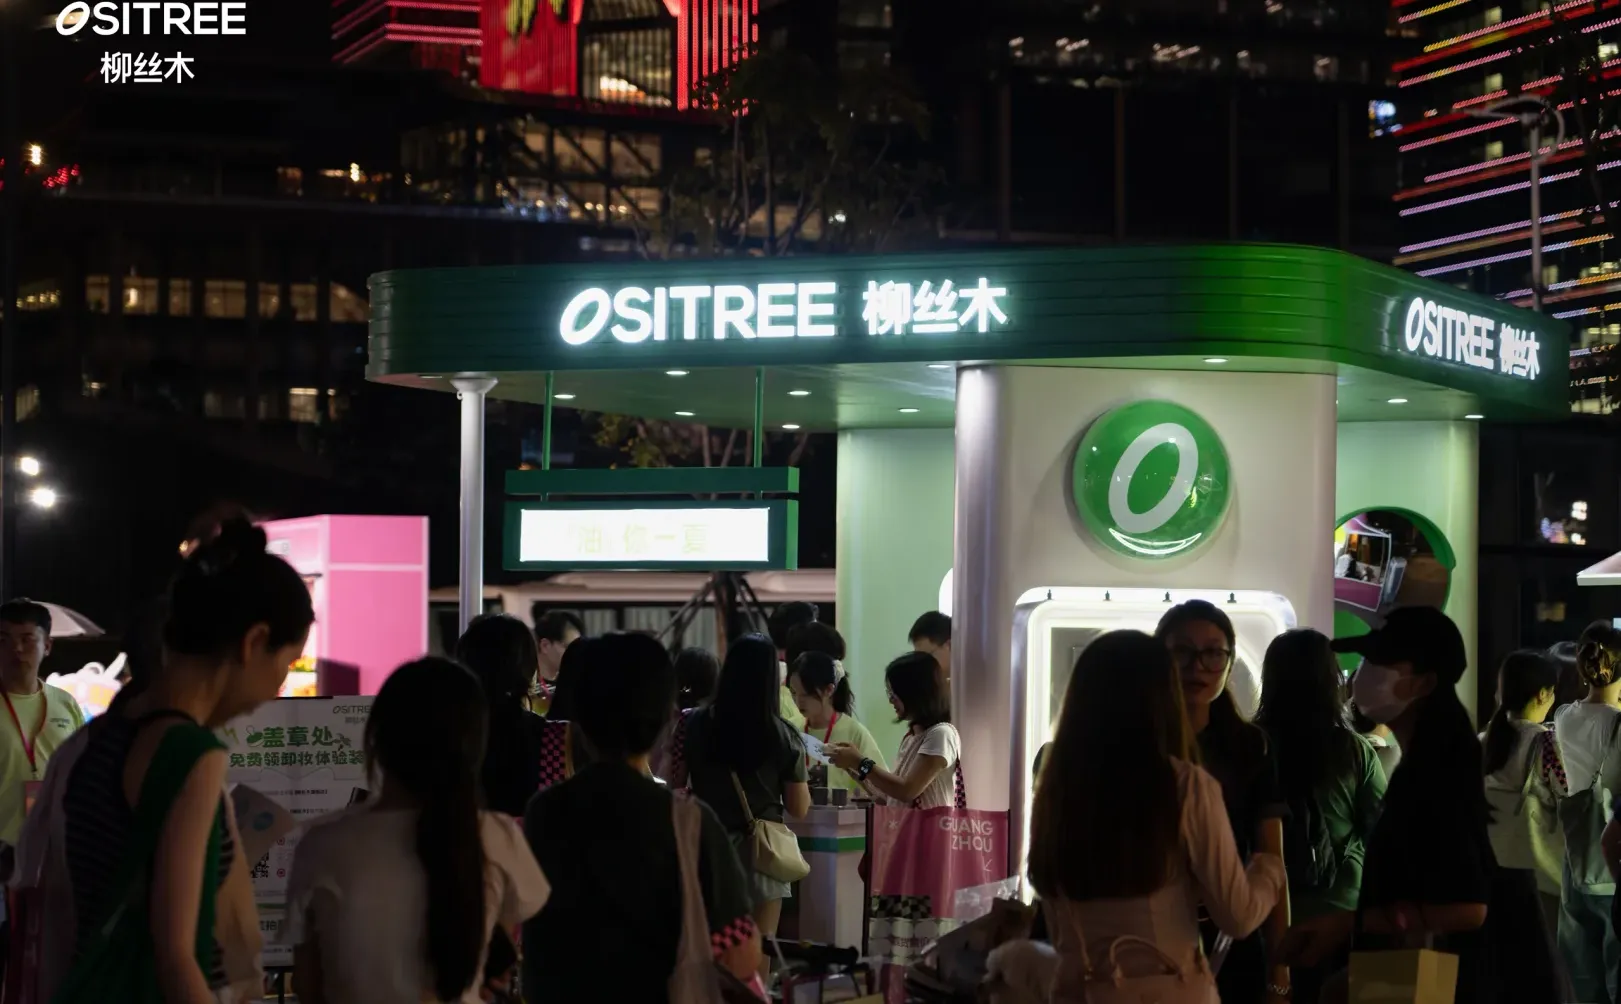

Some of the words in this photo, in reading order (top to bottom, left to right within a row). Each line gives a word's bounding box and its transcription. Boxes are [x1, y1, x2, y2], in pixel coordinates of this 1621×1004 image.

[559, 282, 836, 345] OSITREE
[862, 277, 1008, 336] 柳丝木
[1405, 297, 1495, 370] OSITREE
[332, 705, 372, 714] OSITRE
[263, 726, 334, 748] 盖章处
[230, 750, 364, 768] 免费领卸妆体验装
[939, 816, 993, 836] GUANG
[952, 835, 993, 853] ZHOU
